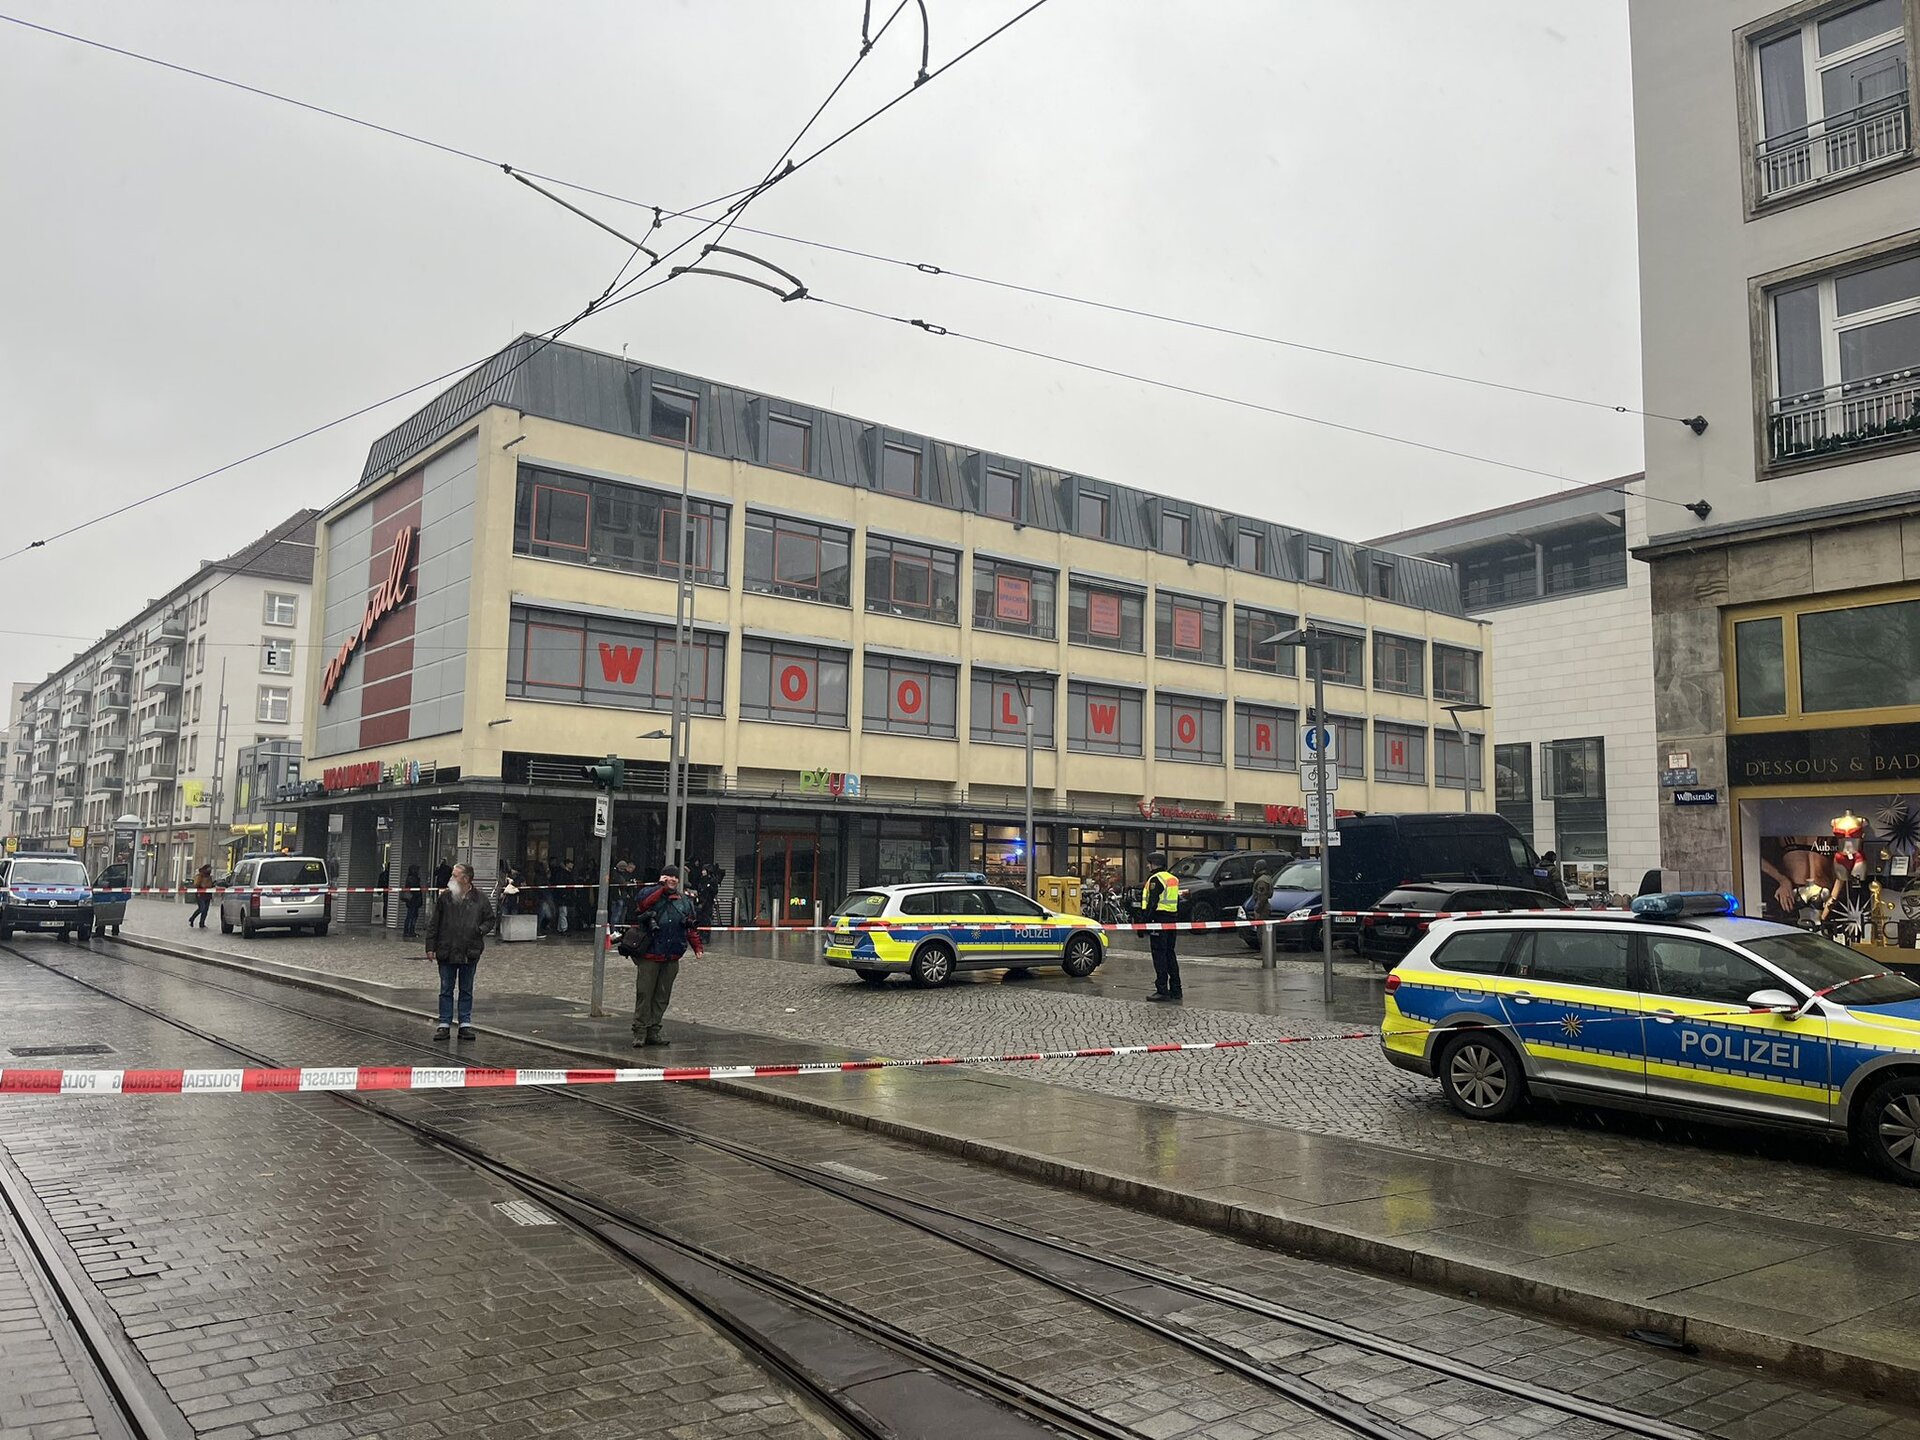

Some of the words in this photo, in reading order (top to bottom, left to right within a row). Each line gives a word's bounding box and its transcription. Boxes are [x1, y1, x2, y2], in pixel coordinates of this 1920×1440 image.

[267, 651, 277, 666] E
[598, 642, 643, 685] W
[780, 665, 808, 702] O
[897, 679, 922, 714] O
[1002, 692, 1018, 724] L
[1089, 703, 1117, 735] W
[1177, 714, 1196, 744] O
[1255, 723, 1271, 752] R
[1391, 740, 1404, 766] H
[1746, 757, 1839, 777] DESSOUS
[1849, 756, 1865, 772] &
[1014, 928, 1052, 939] POLIZEI
[1681, 1029, 1799, 1069] POLIZEI
